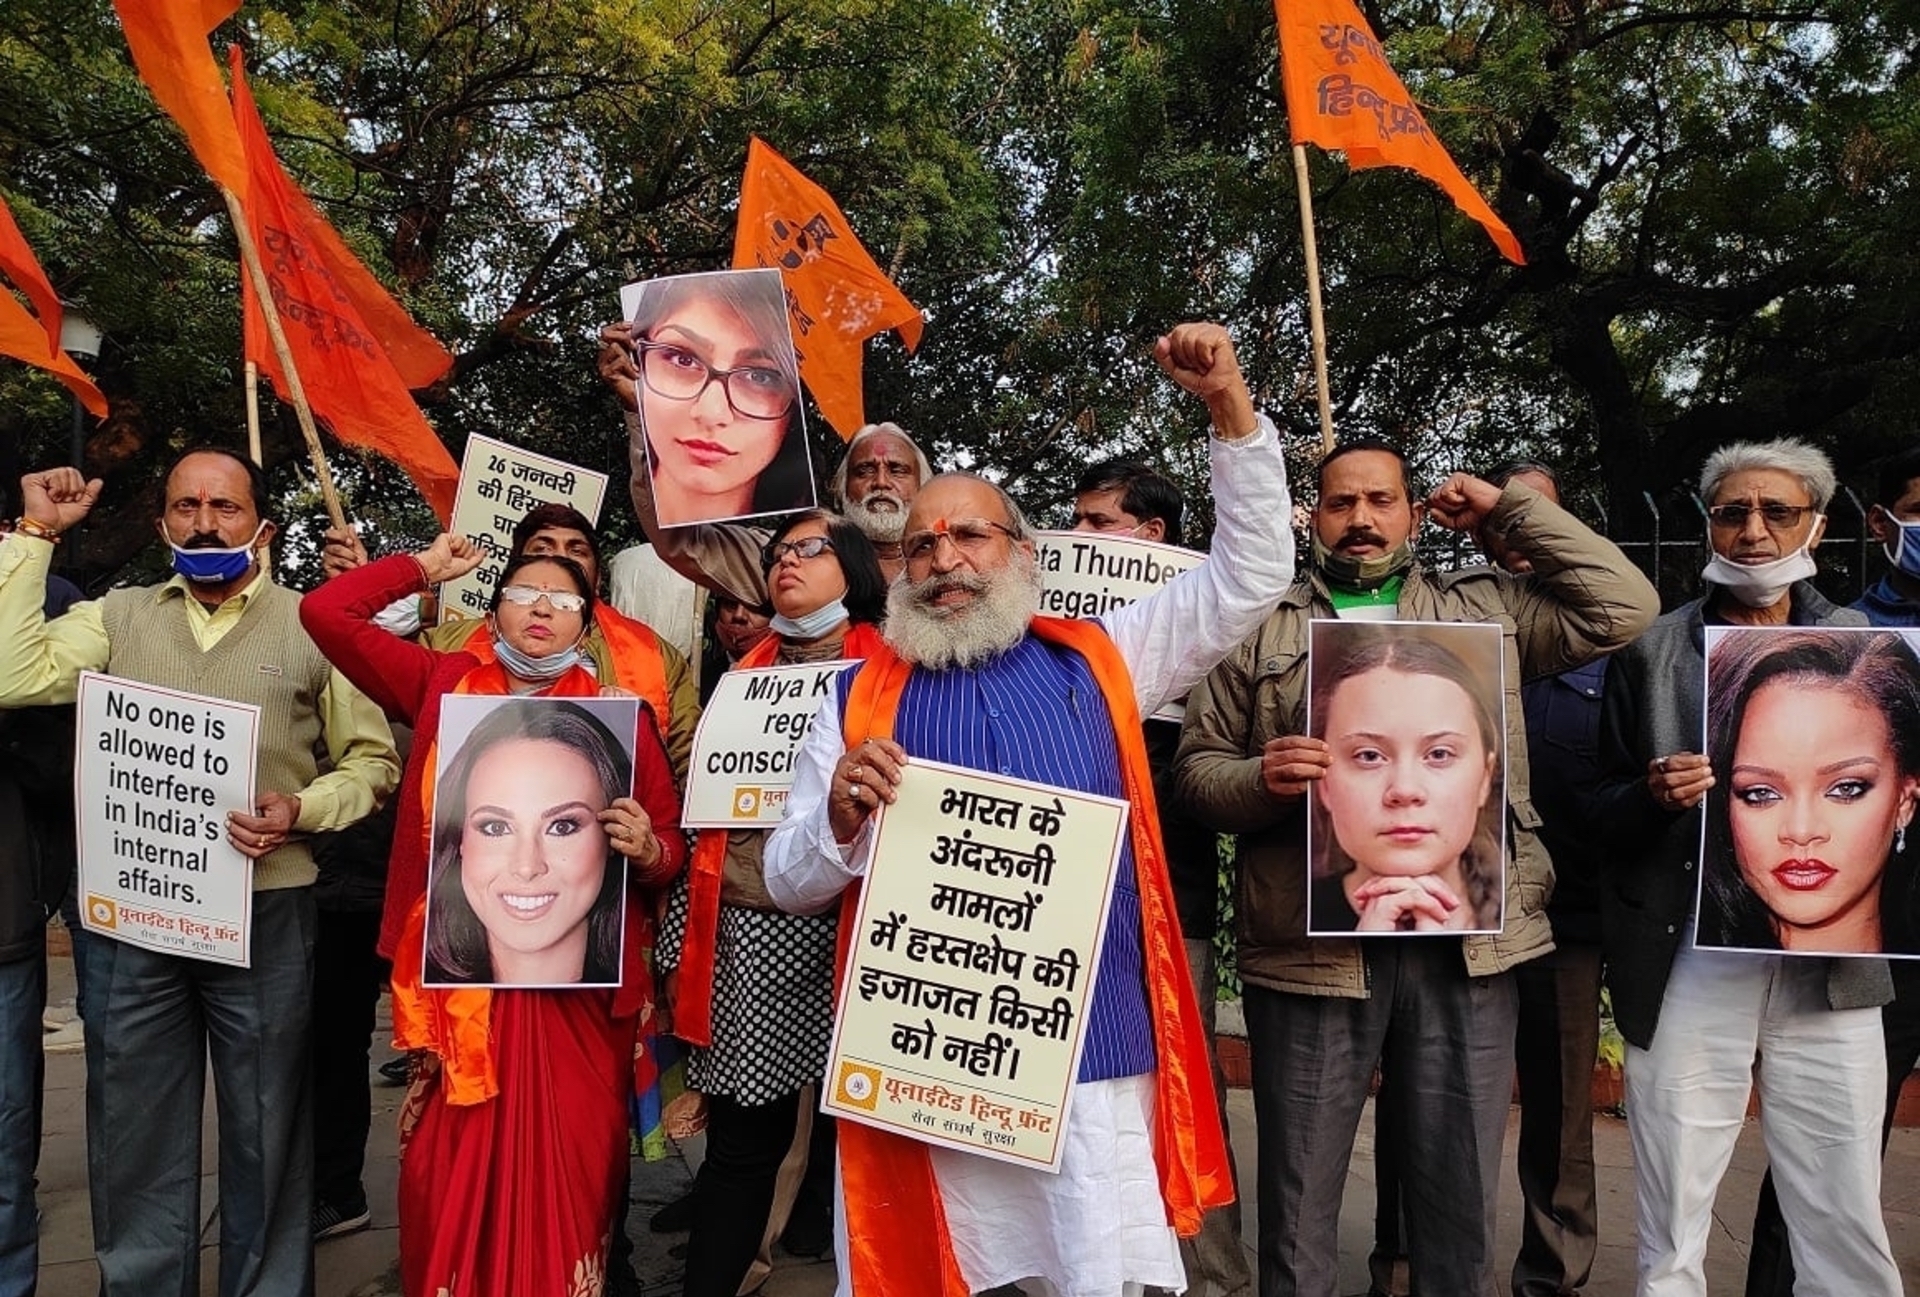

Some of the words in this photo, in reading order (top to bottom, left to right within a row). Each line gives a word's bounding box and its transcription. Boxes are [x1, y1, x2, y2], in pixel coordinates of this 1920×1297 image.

[478, 478, 503, 502] की
[487, 454, 506, 474] 26
[511, 461, 577, 496] जनवरी
[1039, 587, 1137, 620] regain
[744, 675, 805, 706] Miya
[106, 690, 140, 722] No
[149, 707, 195, 734] one
[204, 711, 226, 741] is
[99, 728, 195, 770] allowed
[203, 750, 228, 776] to
[707, 743, 800, 774] consci
[109, 762, 216, 807] interfere
[763, 791, 789, 807] यूना
[105, 795, 126, 823] in
[940, 787, 1022, 831] भारत
[1029, 798, 1067, 837] के
[114, 831, 208, 873] internal
[930, 829, 1057, 887] अंदरूनी
[118, 867, 202, 905] affairs.
[931, 882, 1044, 932] मामलों
[178, 917, 213, 942] हिन्दू
[870, 911, 908, 953] में
[906, 926, 1026, 981] हस्तक्षेप
[1032, 948, 1082, 992] की
[858, 965, 983, 1021] इजाजत
[988, 985, 1075, 1041] किसी
[891, 1018, 937, 1061] को
[911, 1109, 936, 1127] सेवा
[982, 1128, 1017, 1147] सुरक्षा
[969, 1093, 1013, 1132] हिन्दू
